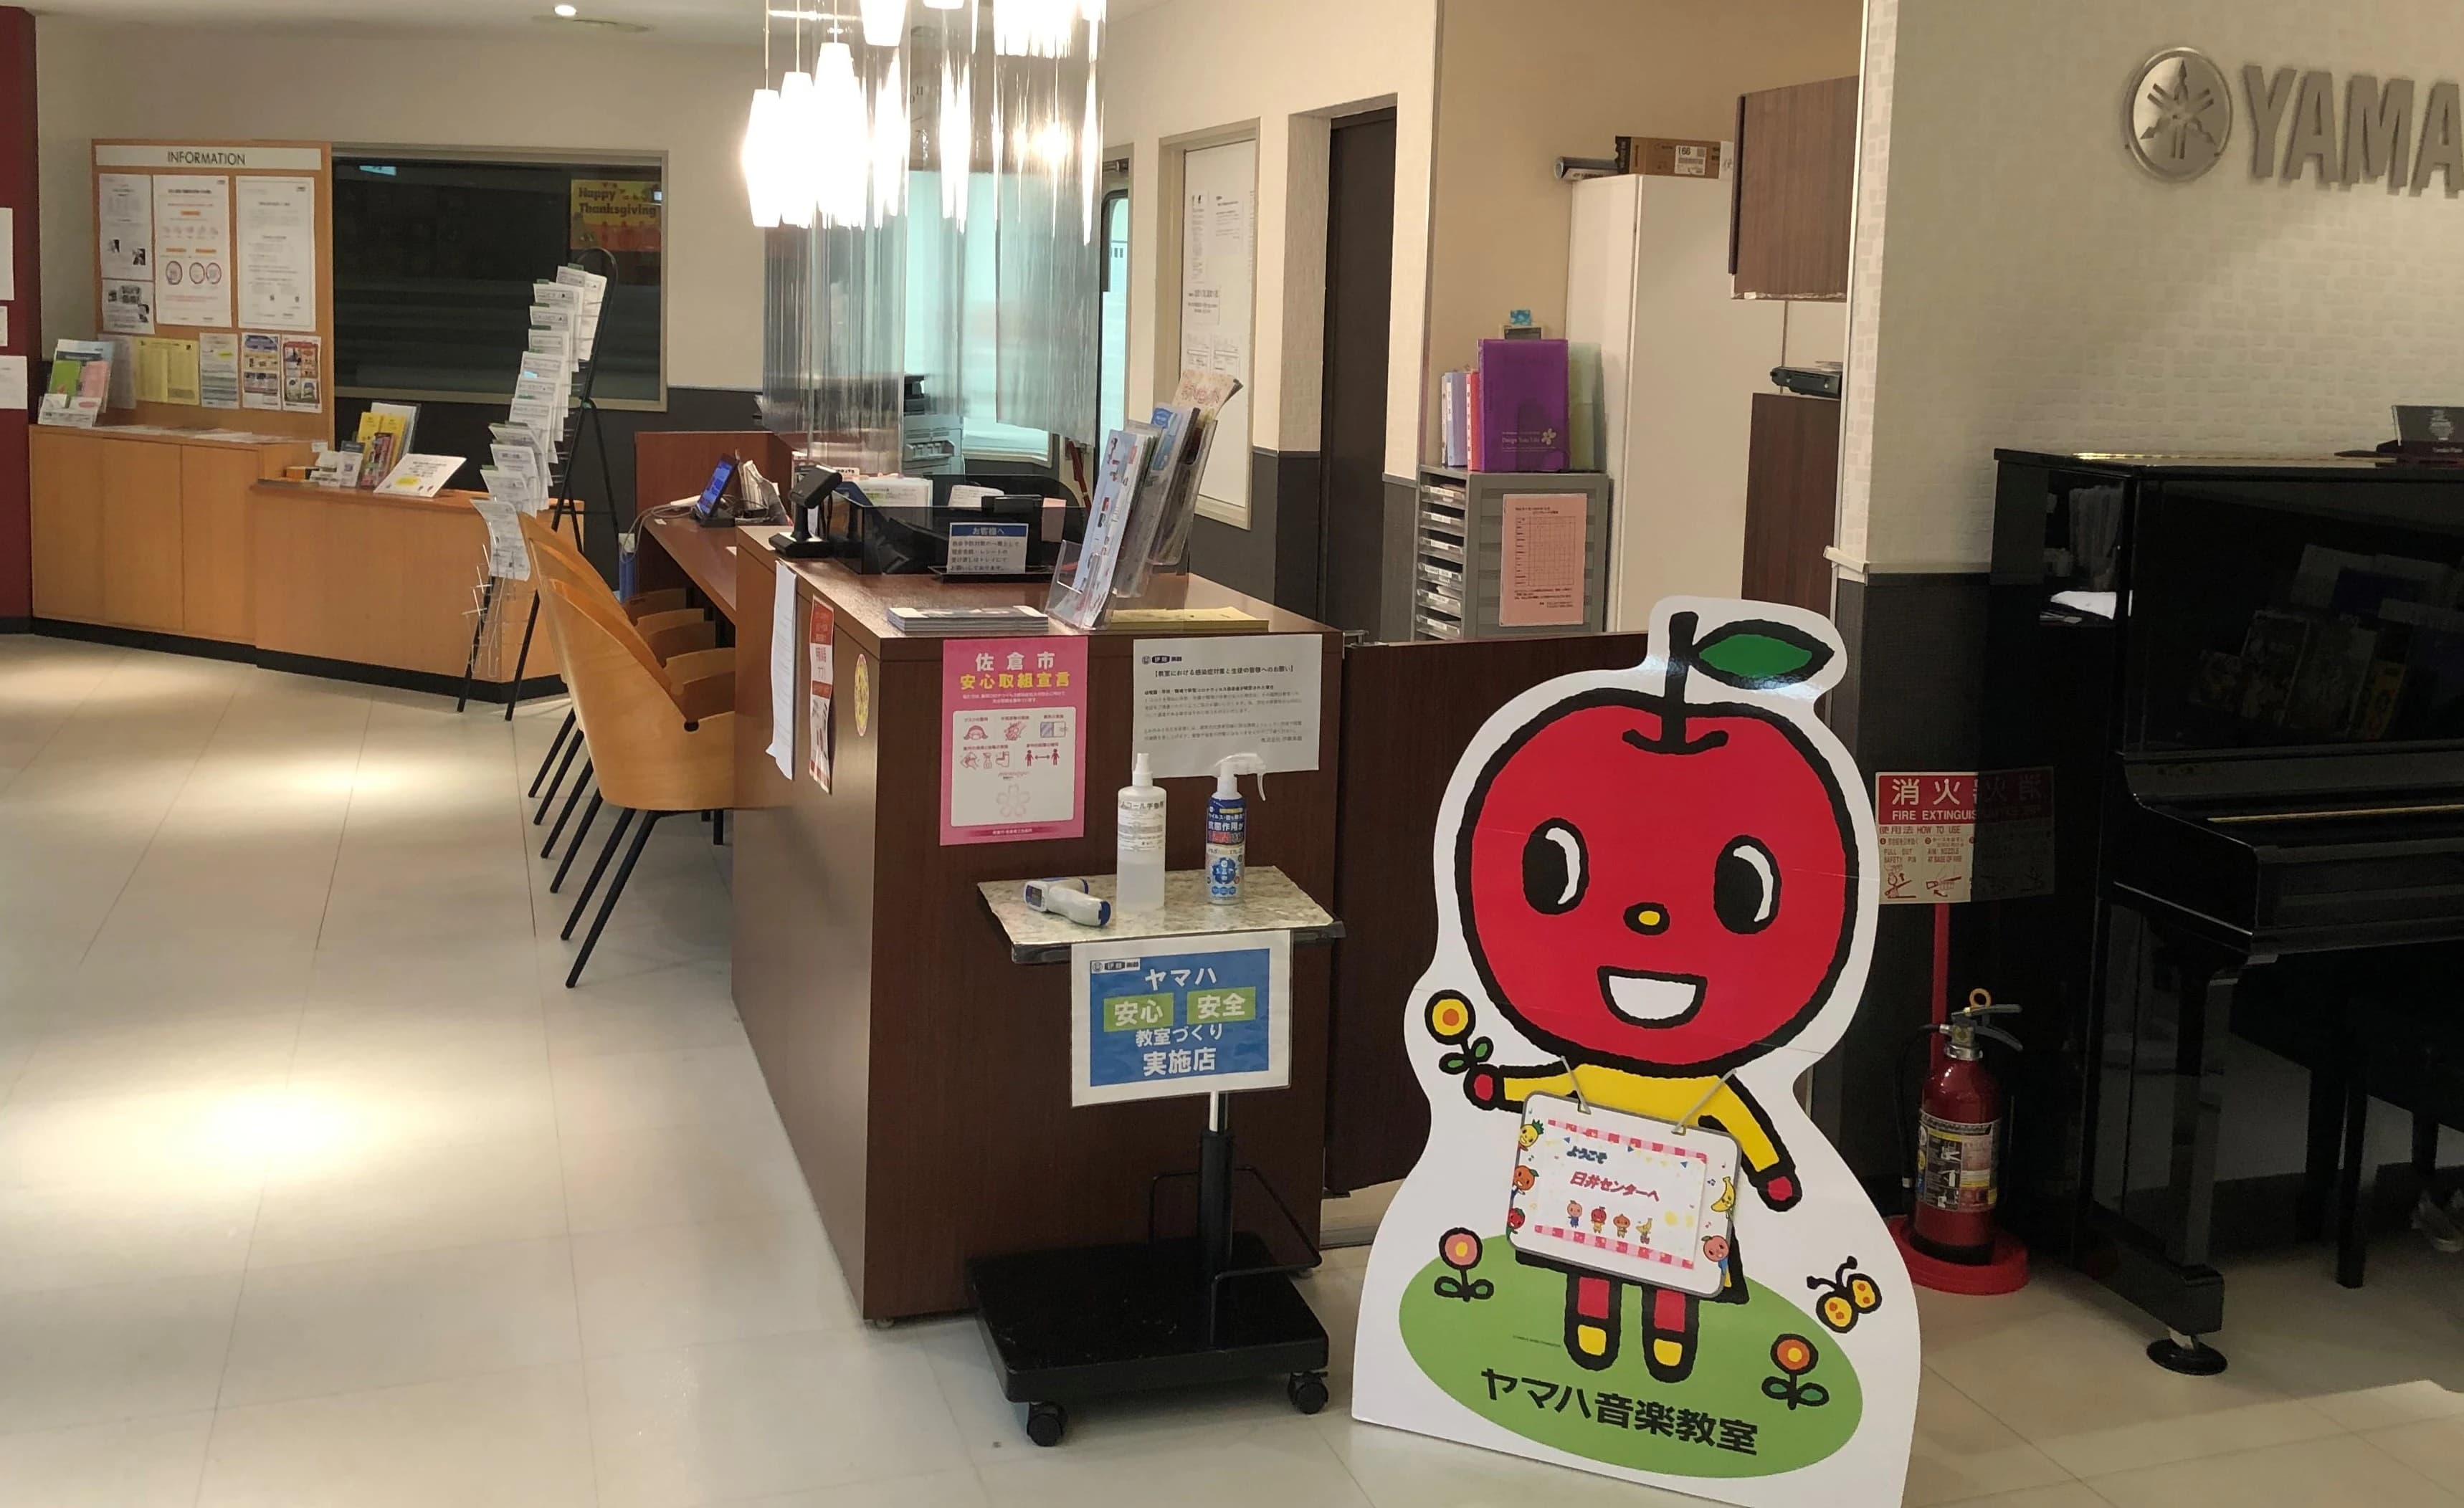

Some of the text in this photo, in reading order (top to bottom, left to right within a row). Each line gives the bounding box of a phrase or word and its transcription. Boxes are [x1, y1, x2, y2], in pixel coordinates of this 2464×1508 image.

[2242, 65, 2464, 198] YAMA
[167, 151, 245, 165] INFORMATION
[579, 187, 616, 201] Happy
[579, 203, 657, 218] Thanksgiving
[974, 651, 1055, 672] 佐倉市
[960, 672, 1070, 690] 安心取組宣言
[1891, 778, 1978, 806] 消火
[1892, 811, 1916, 821] FIRE
[1917, 826, 1931, 834] HOW
[1936, 826, 1944, 834] TO
[1949, 826, 1961, 834] USE
[1144, 967, 1217, 991] ヤマハ
[1114, 993, 1245, 1026] 安心 安全
[1135, 1023, 1223, 1048] 教室づくり
[1143, 1046, 1217, 1077] 実施店
[1566, 1145, 1608, 1165] ようこそ
[1480, 1368, 1759, 1456] ヤマハ音楽教室
